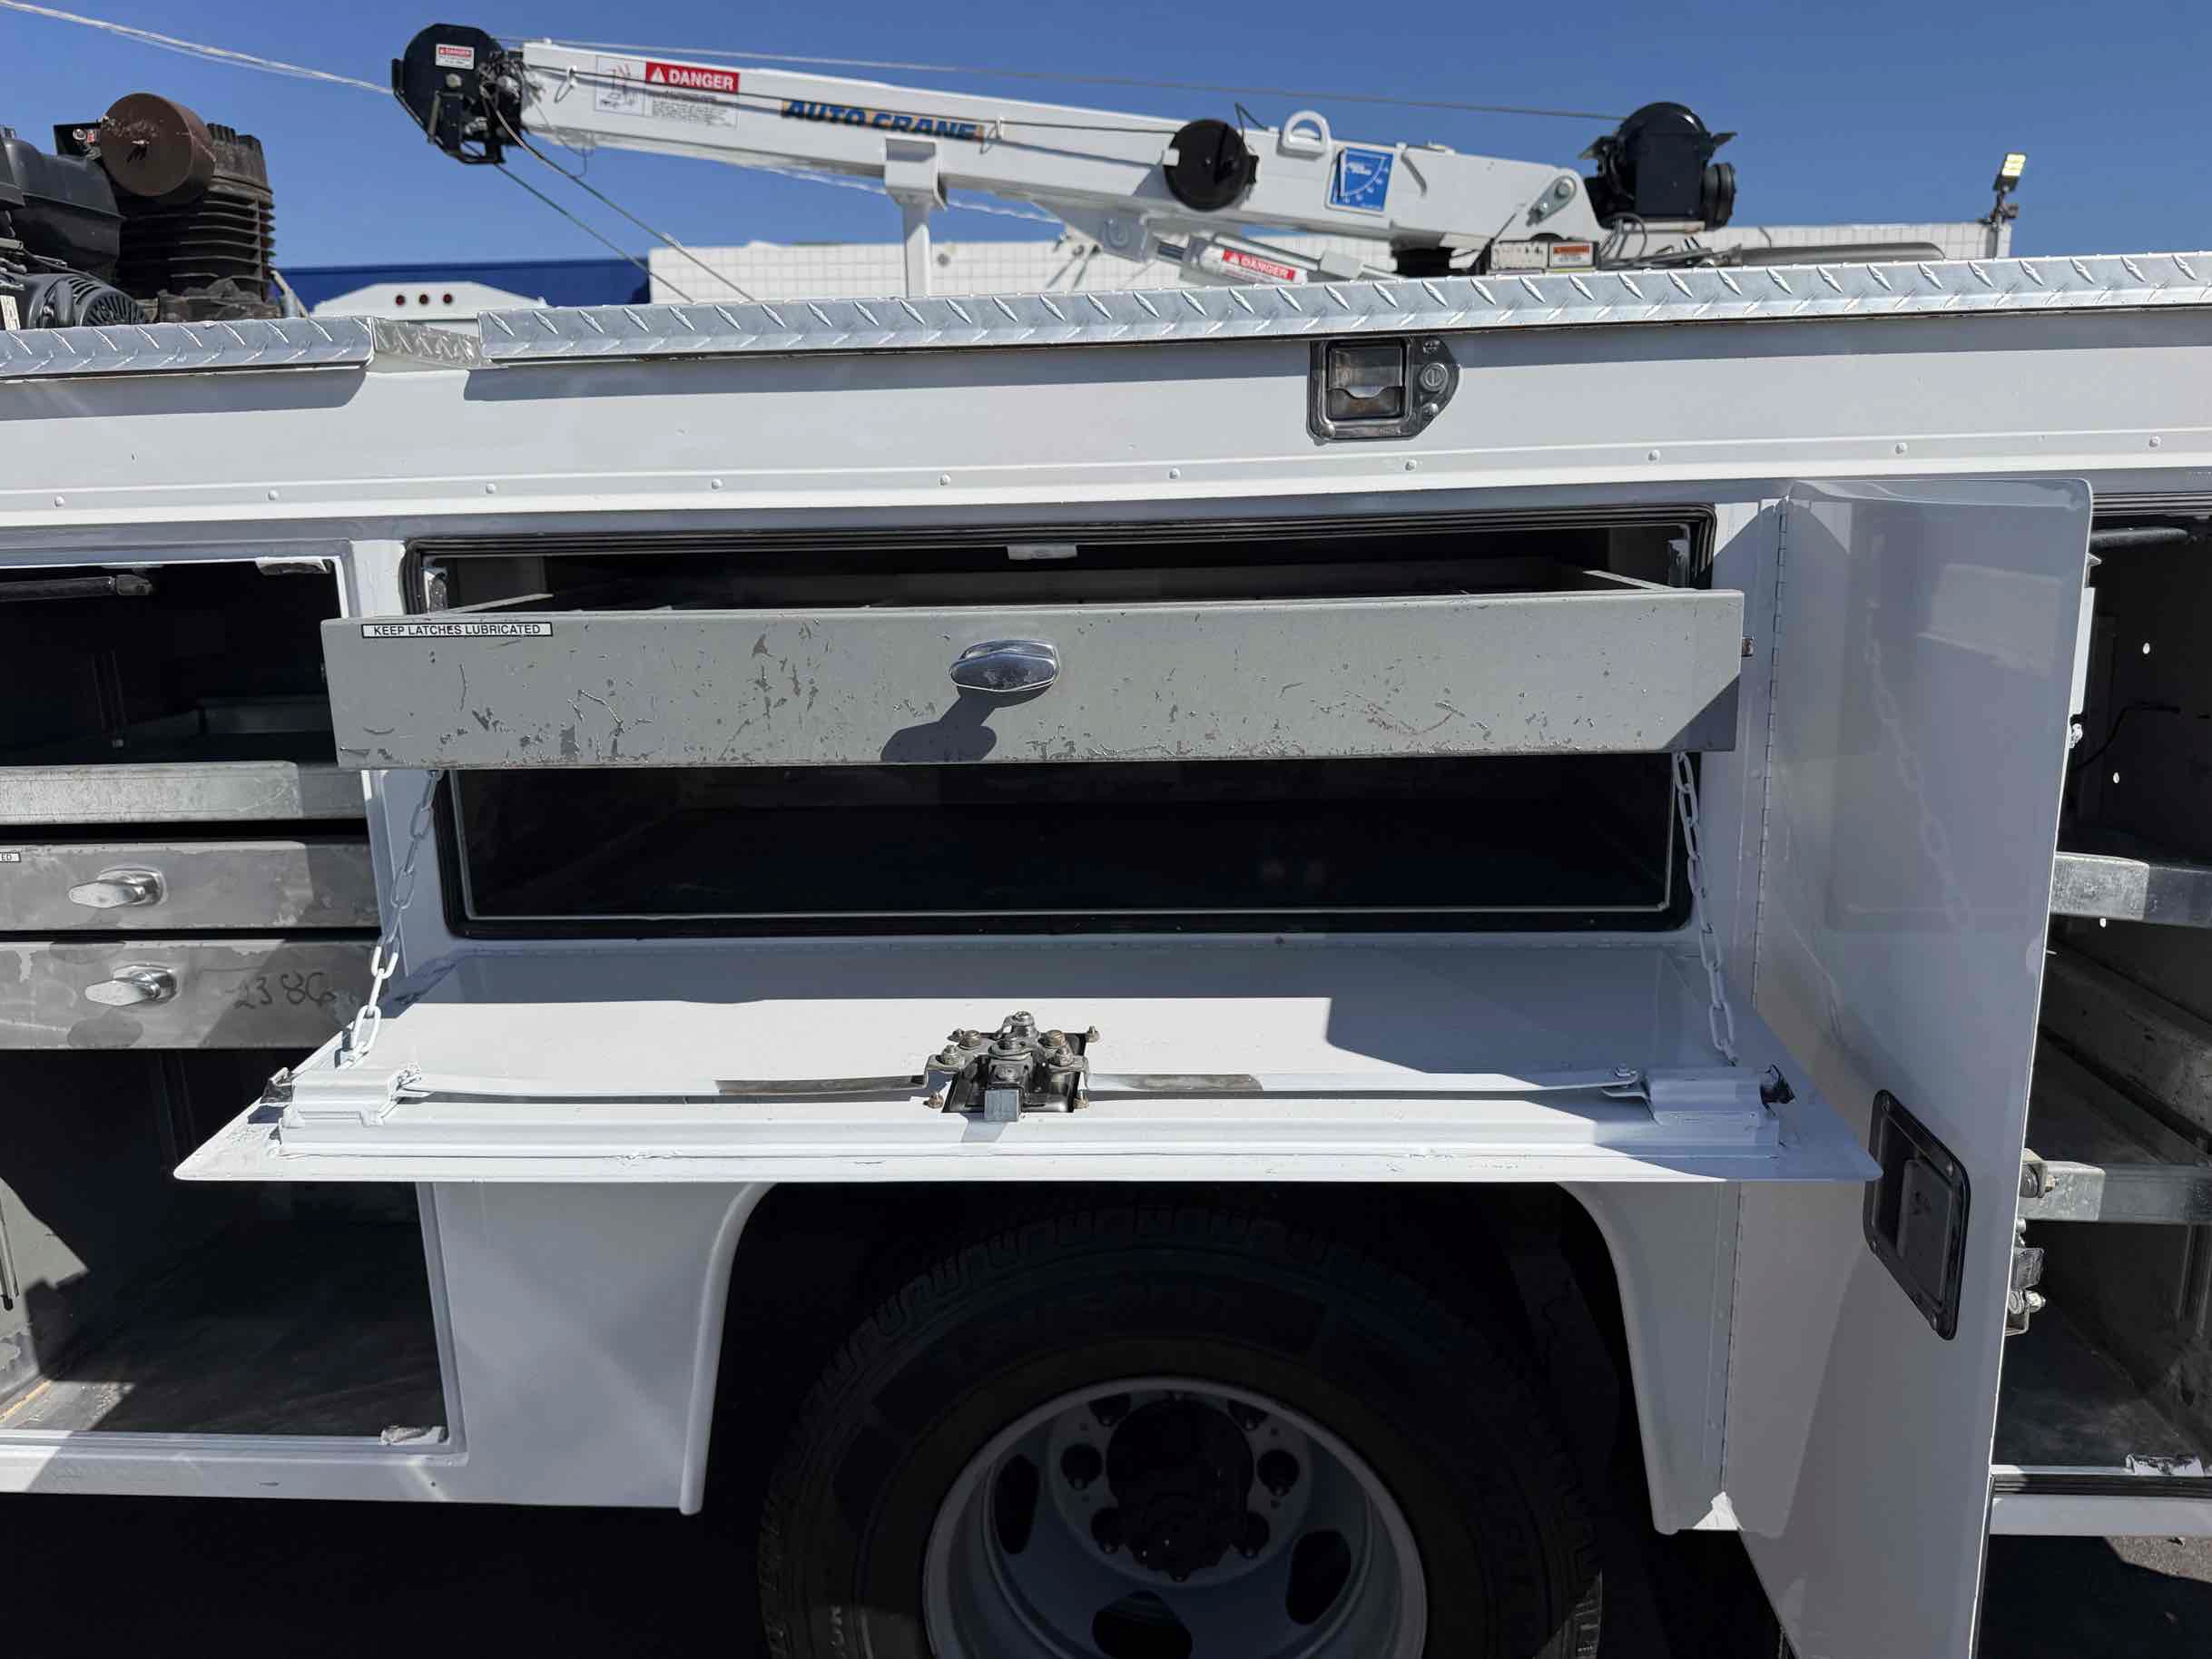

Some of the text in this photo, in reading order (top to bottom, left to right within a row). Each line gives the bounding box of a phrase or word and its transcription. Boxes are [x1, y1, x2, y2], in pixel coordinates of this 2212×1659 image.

[668, 68, 734, 91] DANGER
[786, 100, 978, 139] AUTO CRANE
[373, 624, 541, 635] KEEP LATCHES LUBRICATED
